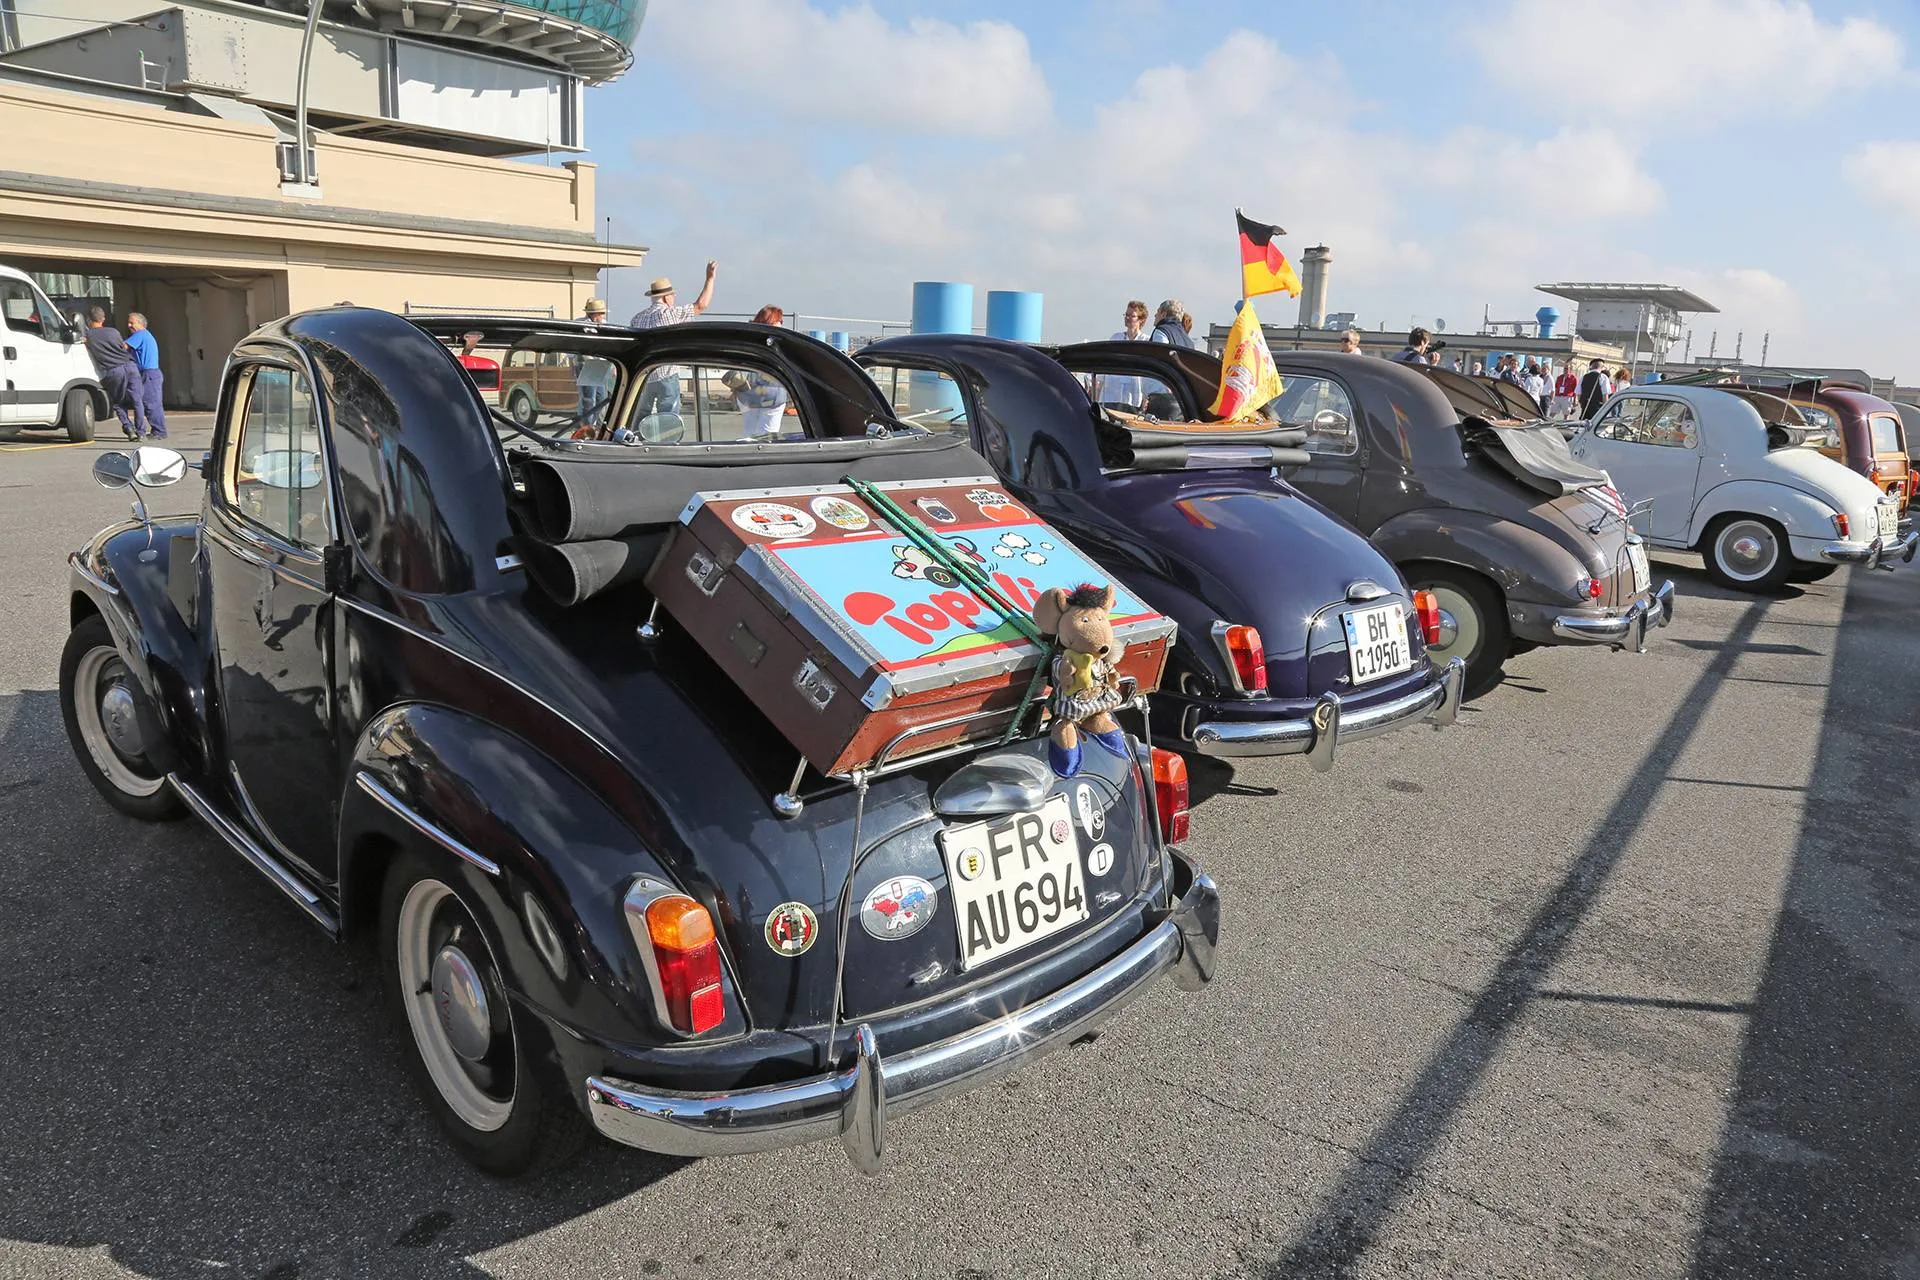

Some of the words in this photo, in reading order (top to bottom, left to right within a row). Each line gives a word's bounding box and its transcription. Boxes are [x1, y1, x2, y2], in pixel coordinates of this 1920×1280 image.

[1367, 611, 1389, 642] BH
[987, 813, 1049, 881] FR
[1097, 849, 1107, 872] D
